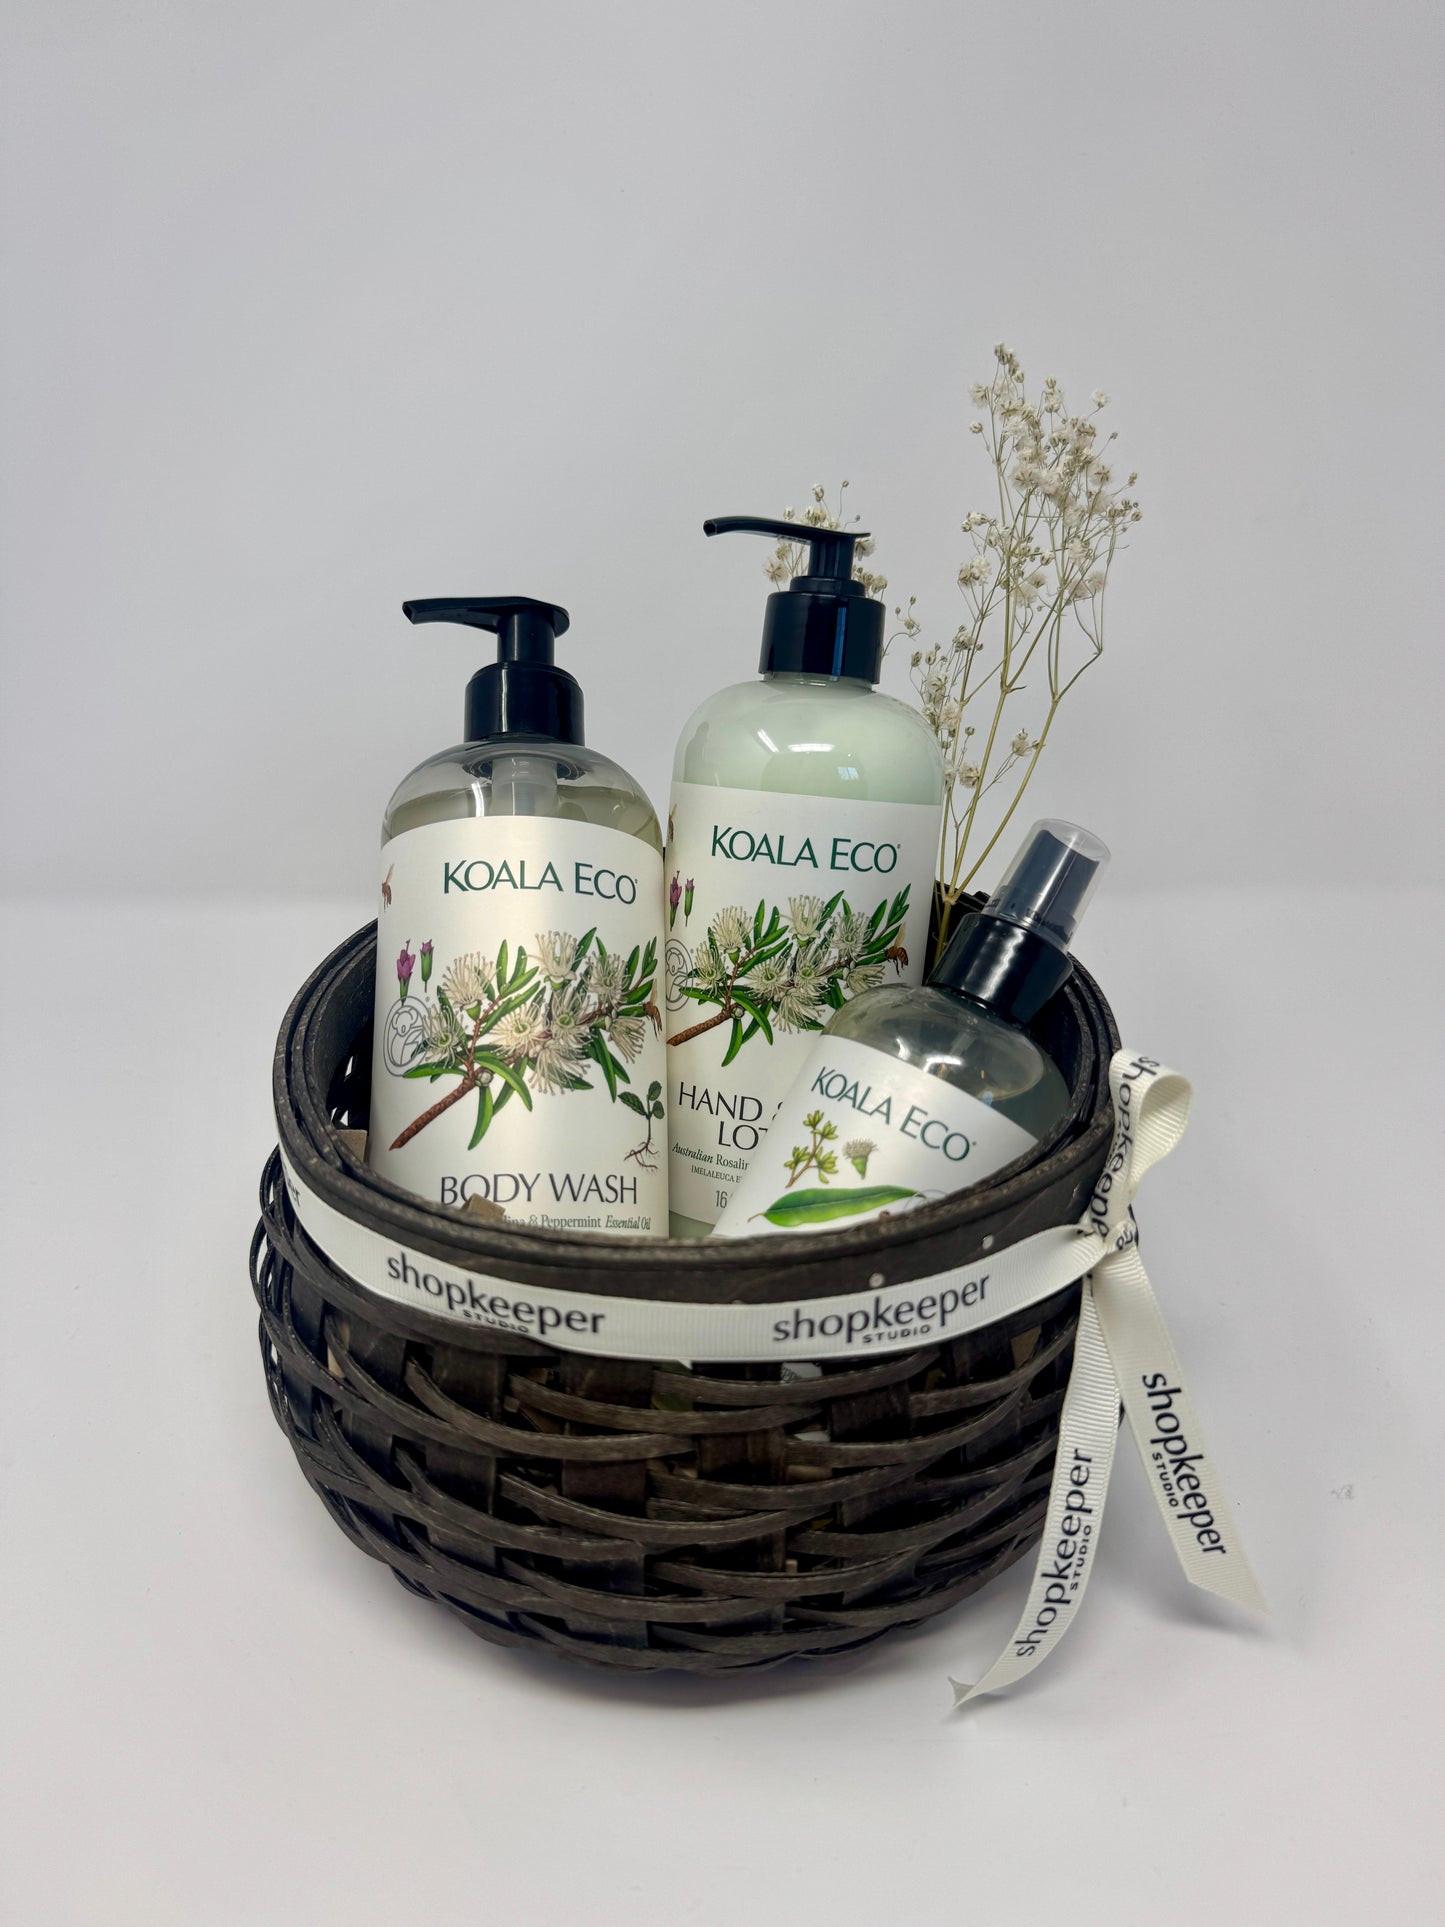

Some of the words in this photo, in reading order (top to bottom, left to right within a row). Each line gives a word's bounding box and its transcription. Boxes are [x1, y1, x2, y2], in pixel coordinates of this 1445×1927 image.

[711, 825, 819, 869] KOALA
[830, 837, 898, 874] ECO
[443, 859, 564, 895] KOALA
[574, 861, 637, 905] ECO
[678, 1081, 763, 1122] HAND
[810, 1066, 892, 1126] KOALA
[899, 1105, 970, 1162] ECO
[671, 1141, 714, 1164] Australian
[1090, 1056, 1160, 1239] shopkeepe
[441, 1172, 541, 1206] BODY
[548, 1172, 638, 1205] WASH
[527, 1213, 539, 1229] &
[541, 1214, 601, 1232] Peppermint
[605, 1214, 641, 1230] Essential
[641, 1216, 651, 1231] Oil
[386, 1251, 606, 1335] shopkeeper
[773, 1274, 990, 1344] shopkeeper
[462, 1308, 529, 1334] STUDIO
[862, 1323, 931, 1344] STUDIO
[1142, 1372, 1227, 1555] shopkeeper
[1152, 1451, 1179, 1508] STUDIO
[1015, 1447, 1093, 1657] shopkeeper
[1069, 1524, 1093, 1591] STUDIO
